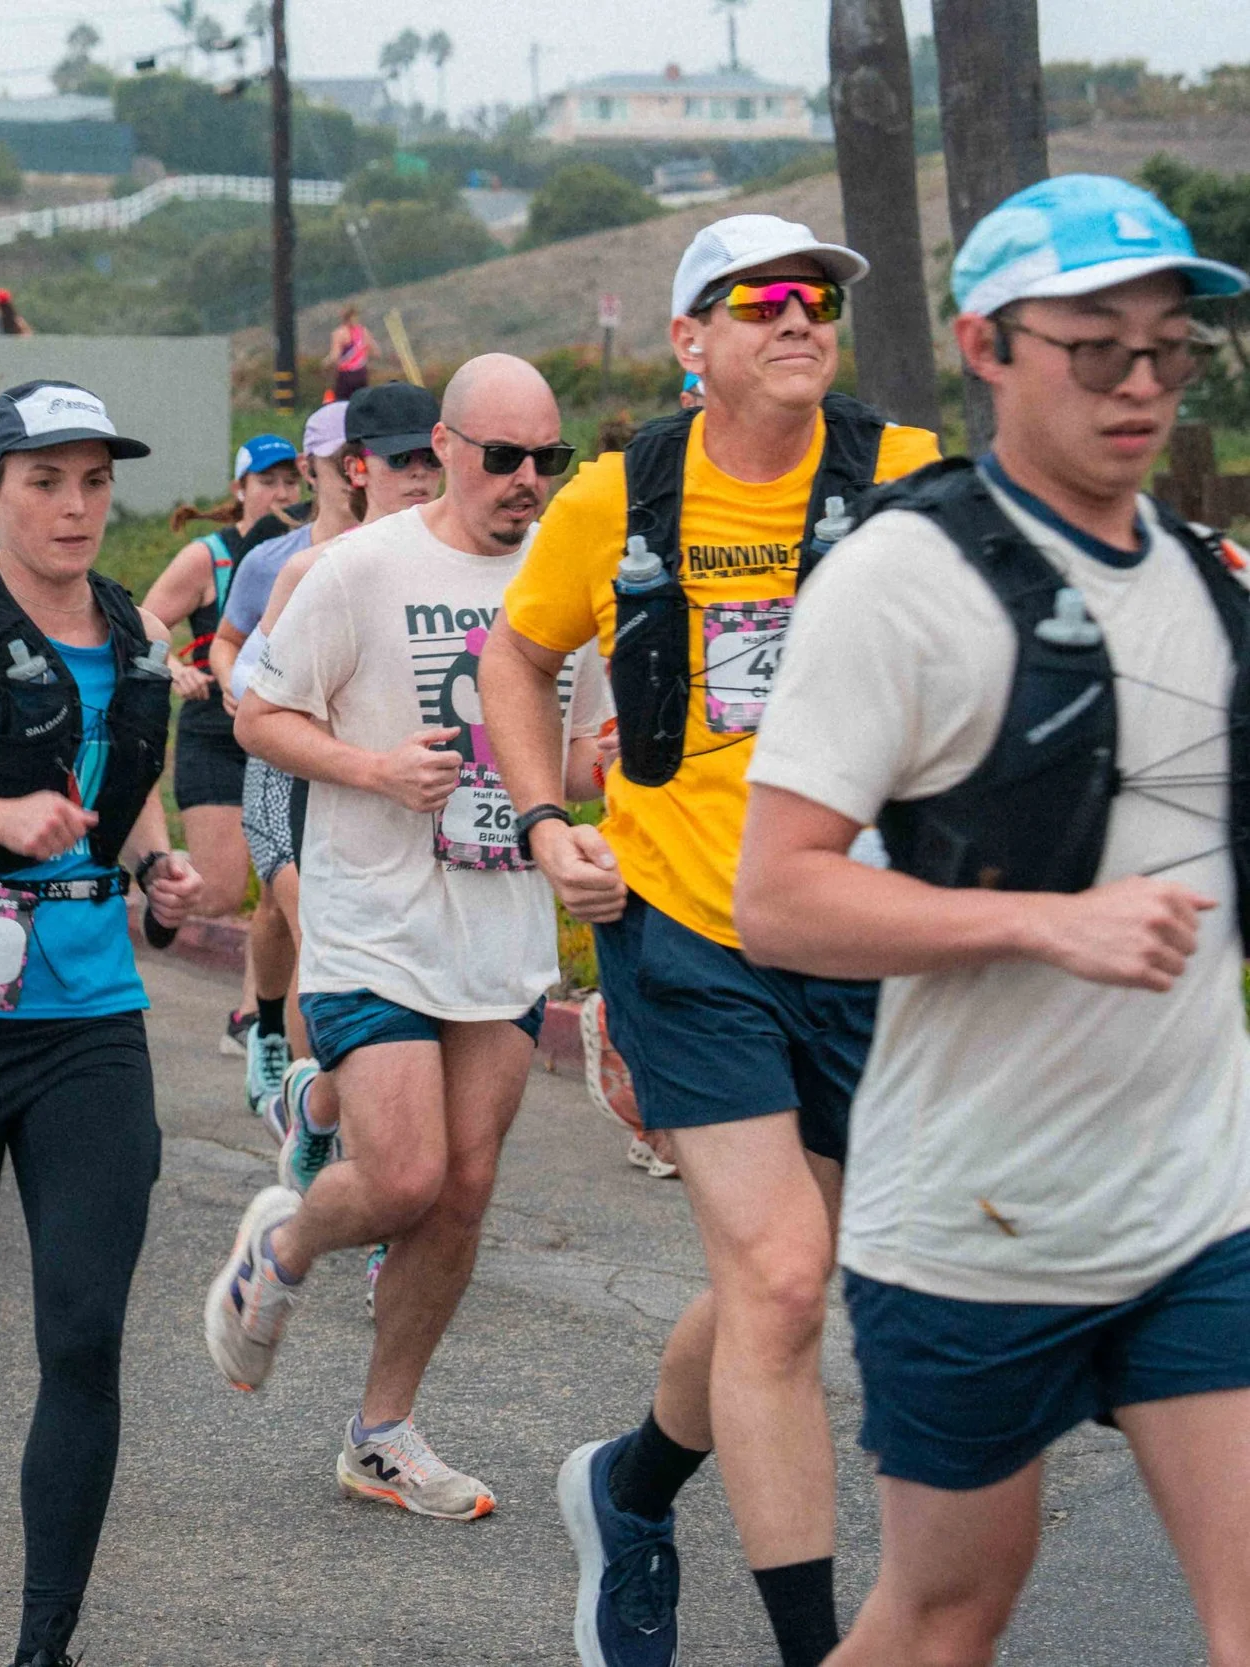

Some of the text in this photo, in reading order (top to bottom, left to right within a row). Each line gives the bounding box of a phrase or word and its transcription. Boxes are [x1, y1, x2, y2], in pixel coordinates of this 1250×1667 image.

[688, 543, 788, 571] RUNNING
[405, 603, 500, 636] mov
[461, 769, 477, 780] IPS
[473, 791, 493, 799] Half
[473, 802, 514, 830] 26
